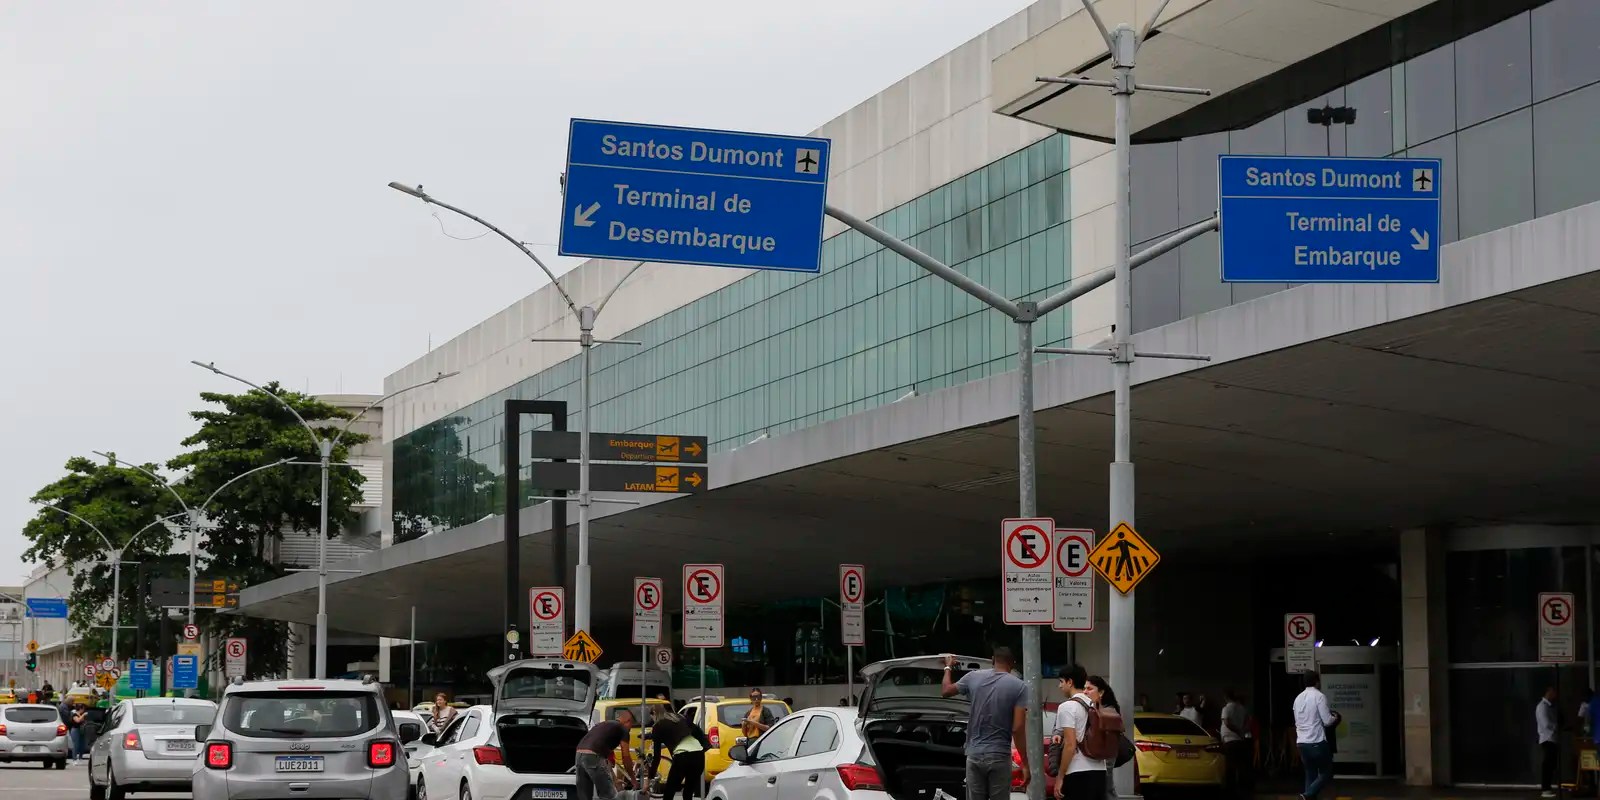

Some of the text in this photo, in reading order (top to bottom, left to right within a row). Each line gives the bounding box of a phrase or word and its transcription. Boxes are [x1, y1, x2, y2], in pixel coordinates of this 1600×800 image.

[600, 134, 784, 168] Santos Dumont
[1246, 167, 1402, 189] Santos Dumont
[613, 183, 751, 214] Terminal de
[1286, 211, 1401, 233] Terminal de
[608, 220, 776, 255] Desembarque
[1294, 245, 1401, 271] Embarque
[610, 439, 655, 450] Embarque
[624, 482, 655, 491] LATAM
[1021, 535, 1035, 558] E
[1067, 545, 1080, 567] E
[697, 576, 710, 596] E
[849, 577, 856, 595] E
[644, 589, 652, 603] E
[542, 598, 552, 614] E
[1551, 603, 1562, 620] E
[1295, 620, 1306, 635] E
[290, 742, 311, 752] Jeep
[279, 761, 318, 770] LUE2D11
